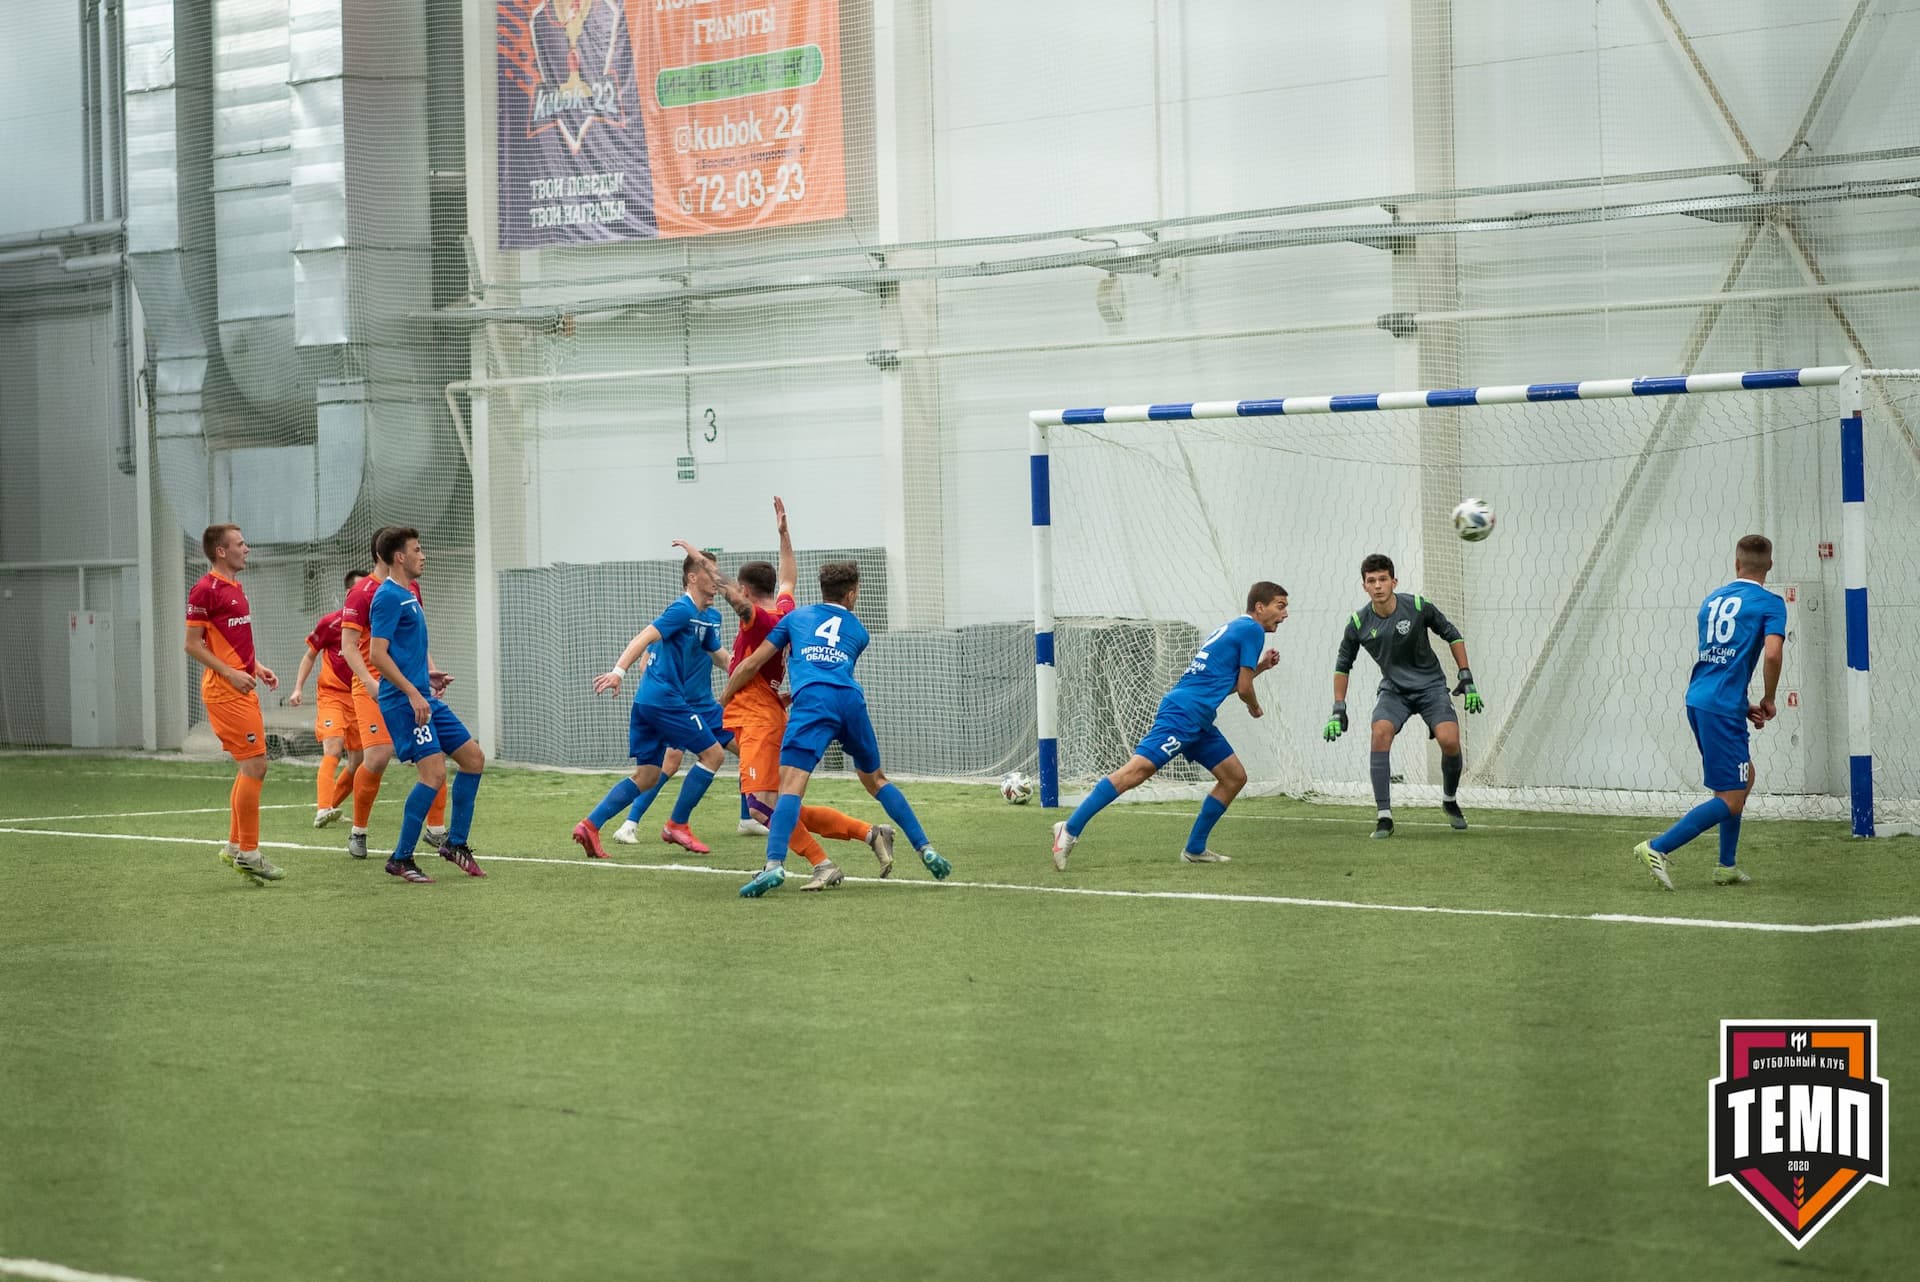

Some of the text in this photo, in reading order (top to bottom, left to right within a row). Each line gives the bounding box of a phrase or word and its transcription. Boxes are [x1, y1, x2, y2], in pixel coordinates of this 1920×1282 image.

[693, 7, 776, 45] ГРАМОТЫ
[530, 178, 564, 200] ТВОИ
[695, 162, 805, 214] 72-03-23
[529, 206, 562, 228] ТВОИ
[704, 408, 717, 443] 3
[1706, 596, 1743, 644] 18
[815, 616, 843, 648] 4
[690, 714, 703, 731] 7
[412, 726, 433, 745] 33
[1159, 735, 1182, 757] 22
[748, 767, 757, 781] 4
